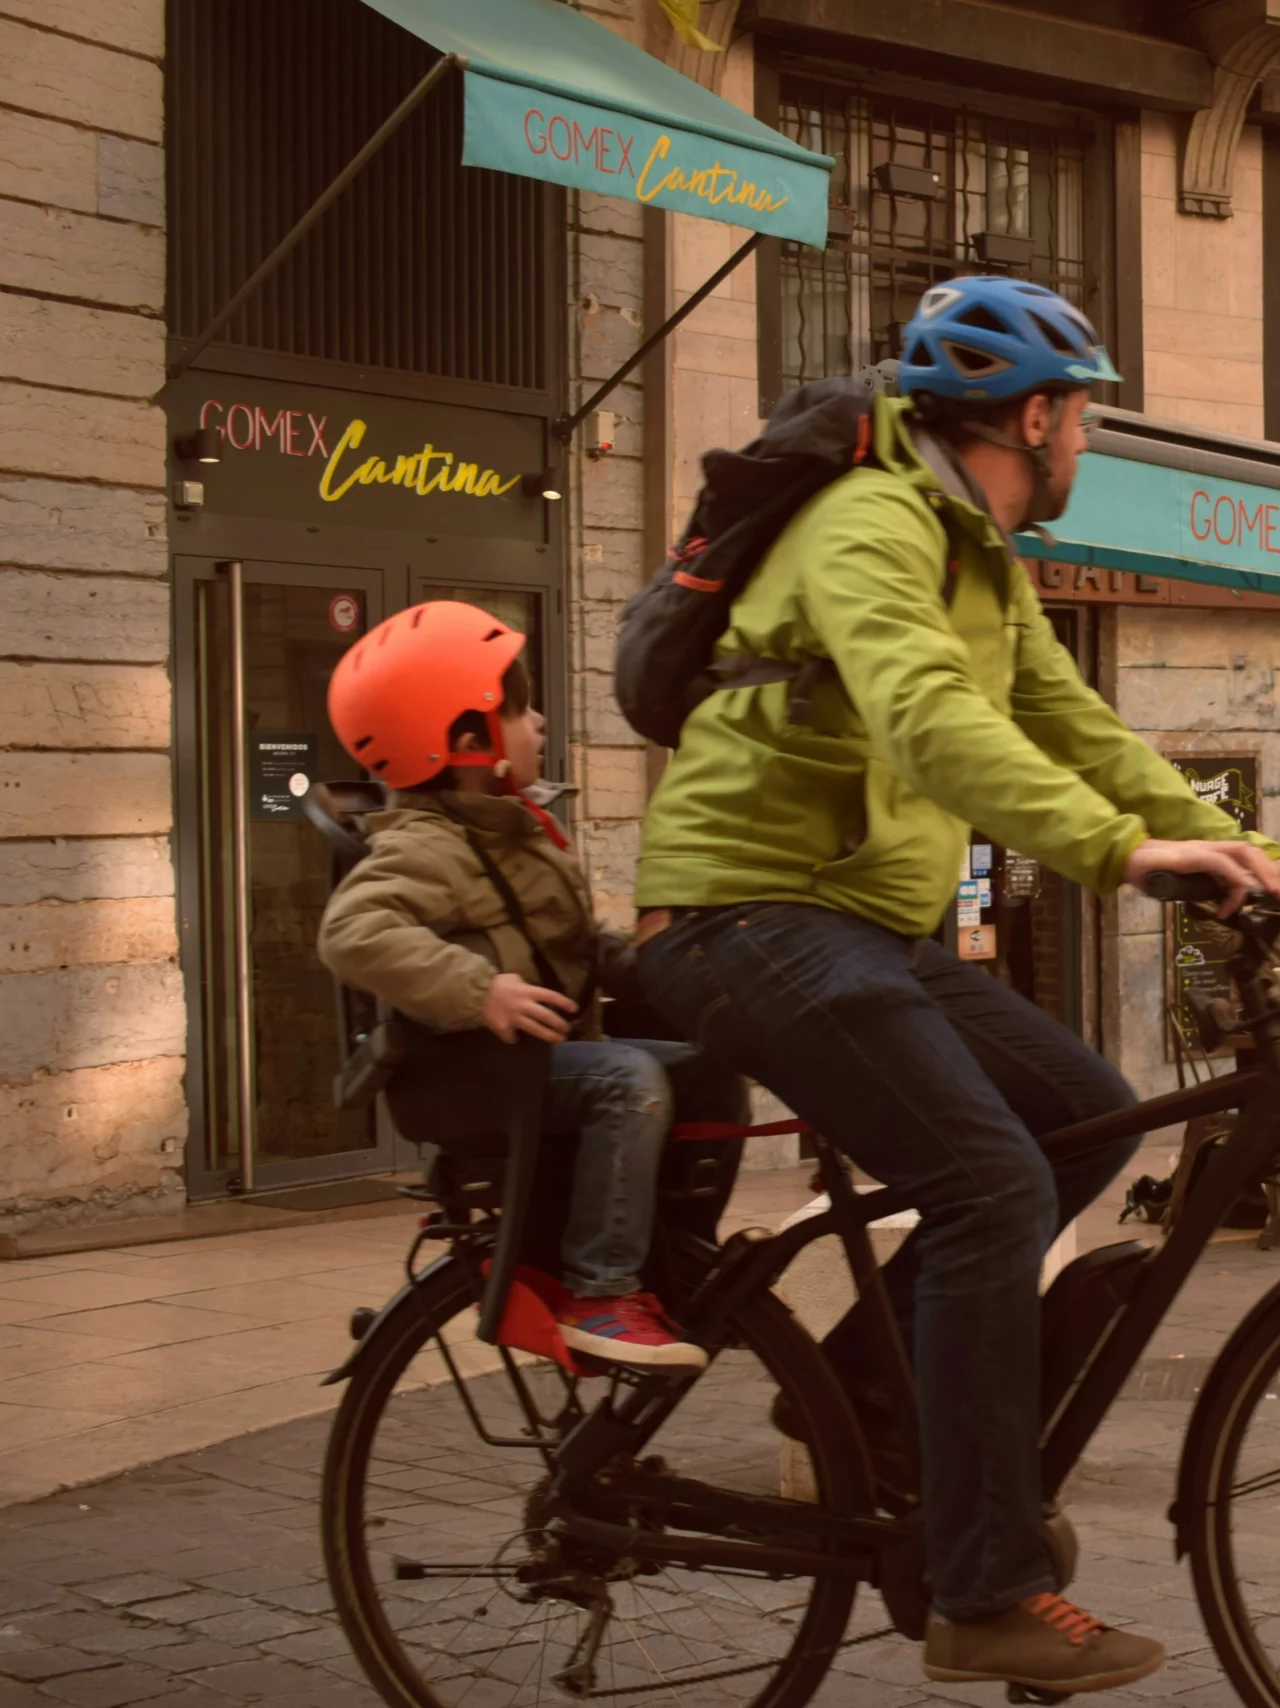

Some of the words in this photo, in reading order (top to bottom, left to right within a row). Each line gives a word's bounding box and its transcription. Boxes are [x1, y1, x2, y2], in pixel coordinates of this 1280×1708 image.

[524, 108, 635, 179] GOMEX
[635, 134, 789, 213] Cantina
[199, 399, 328, 458] GOMEX
[318, 418, 521, 502] Cantina
[1190, 772, 1229, 792] NUAGE
